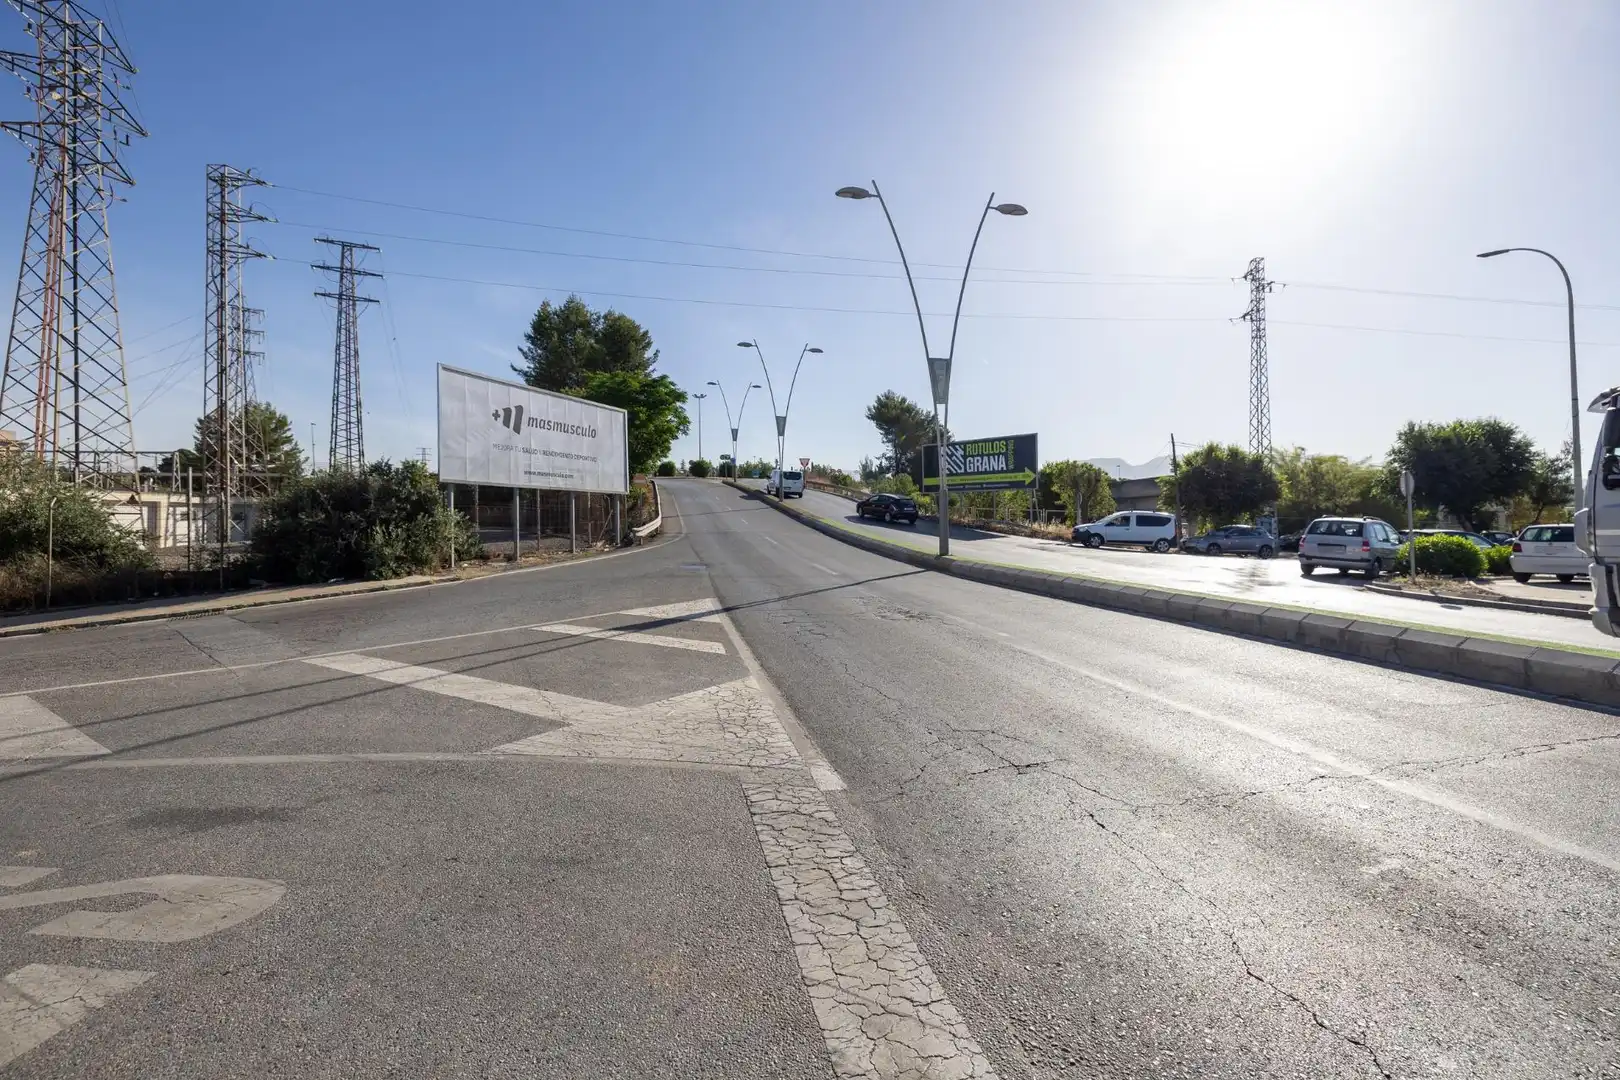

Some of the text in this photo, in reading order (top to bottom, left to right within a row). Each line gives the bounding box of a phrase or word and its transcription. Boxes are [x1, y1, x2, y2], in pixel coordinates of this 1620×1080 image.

[527, 416, 597, 439] masmusculo
[492, 443, 514, 452] MEJORA
[522, 446, 538, 456] SALUD
[966, 440, 1006, 456] ROTULOS
[966, 454, 1007, 473] GRANA
